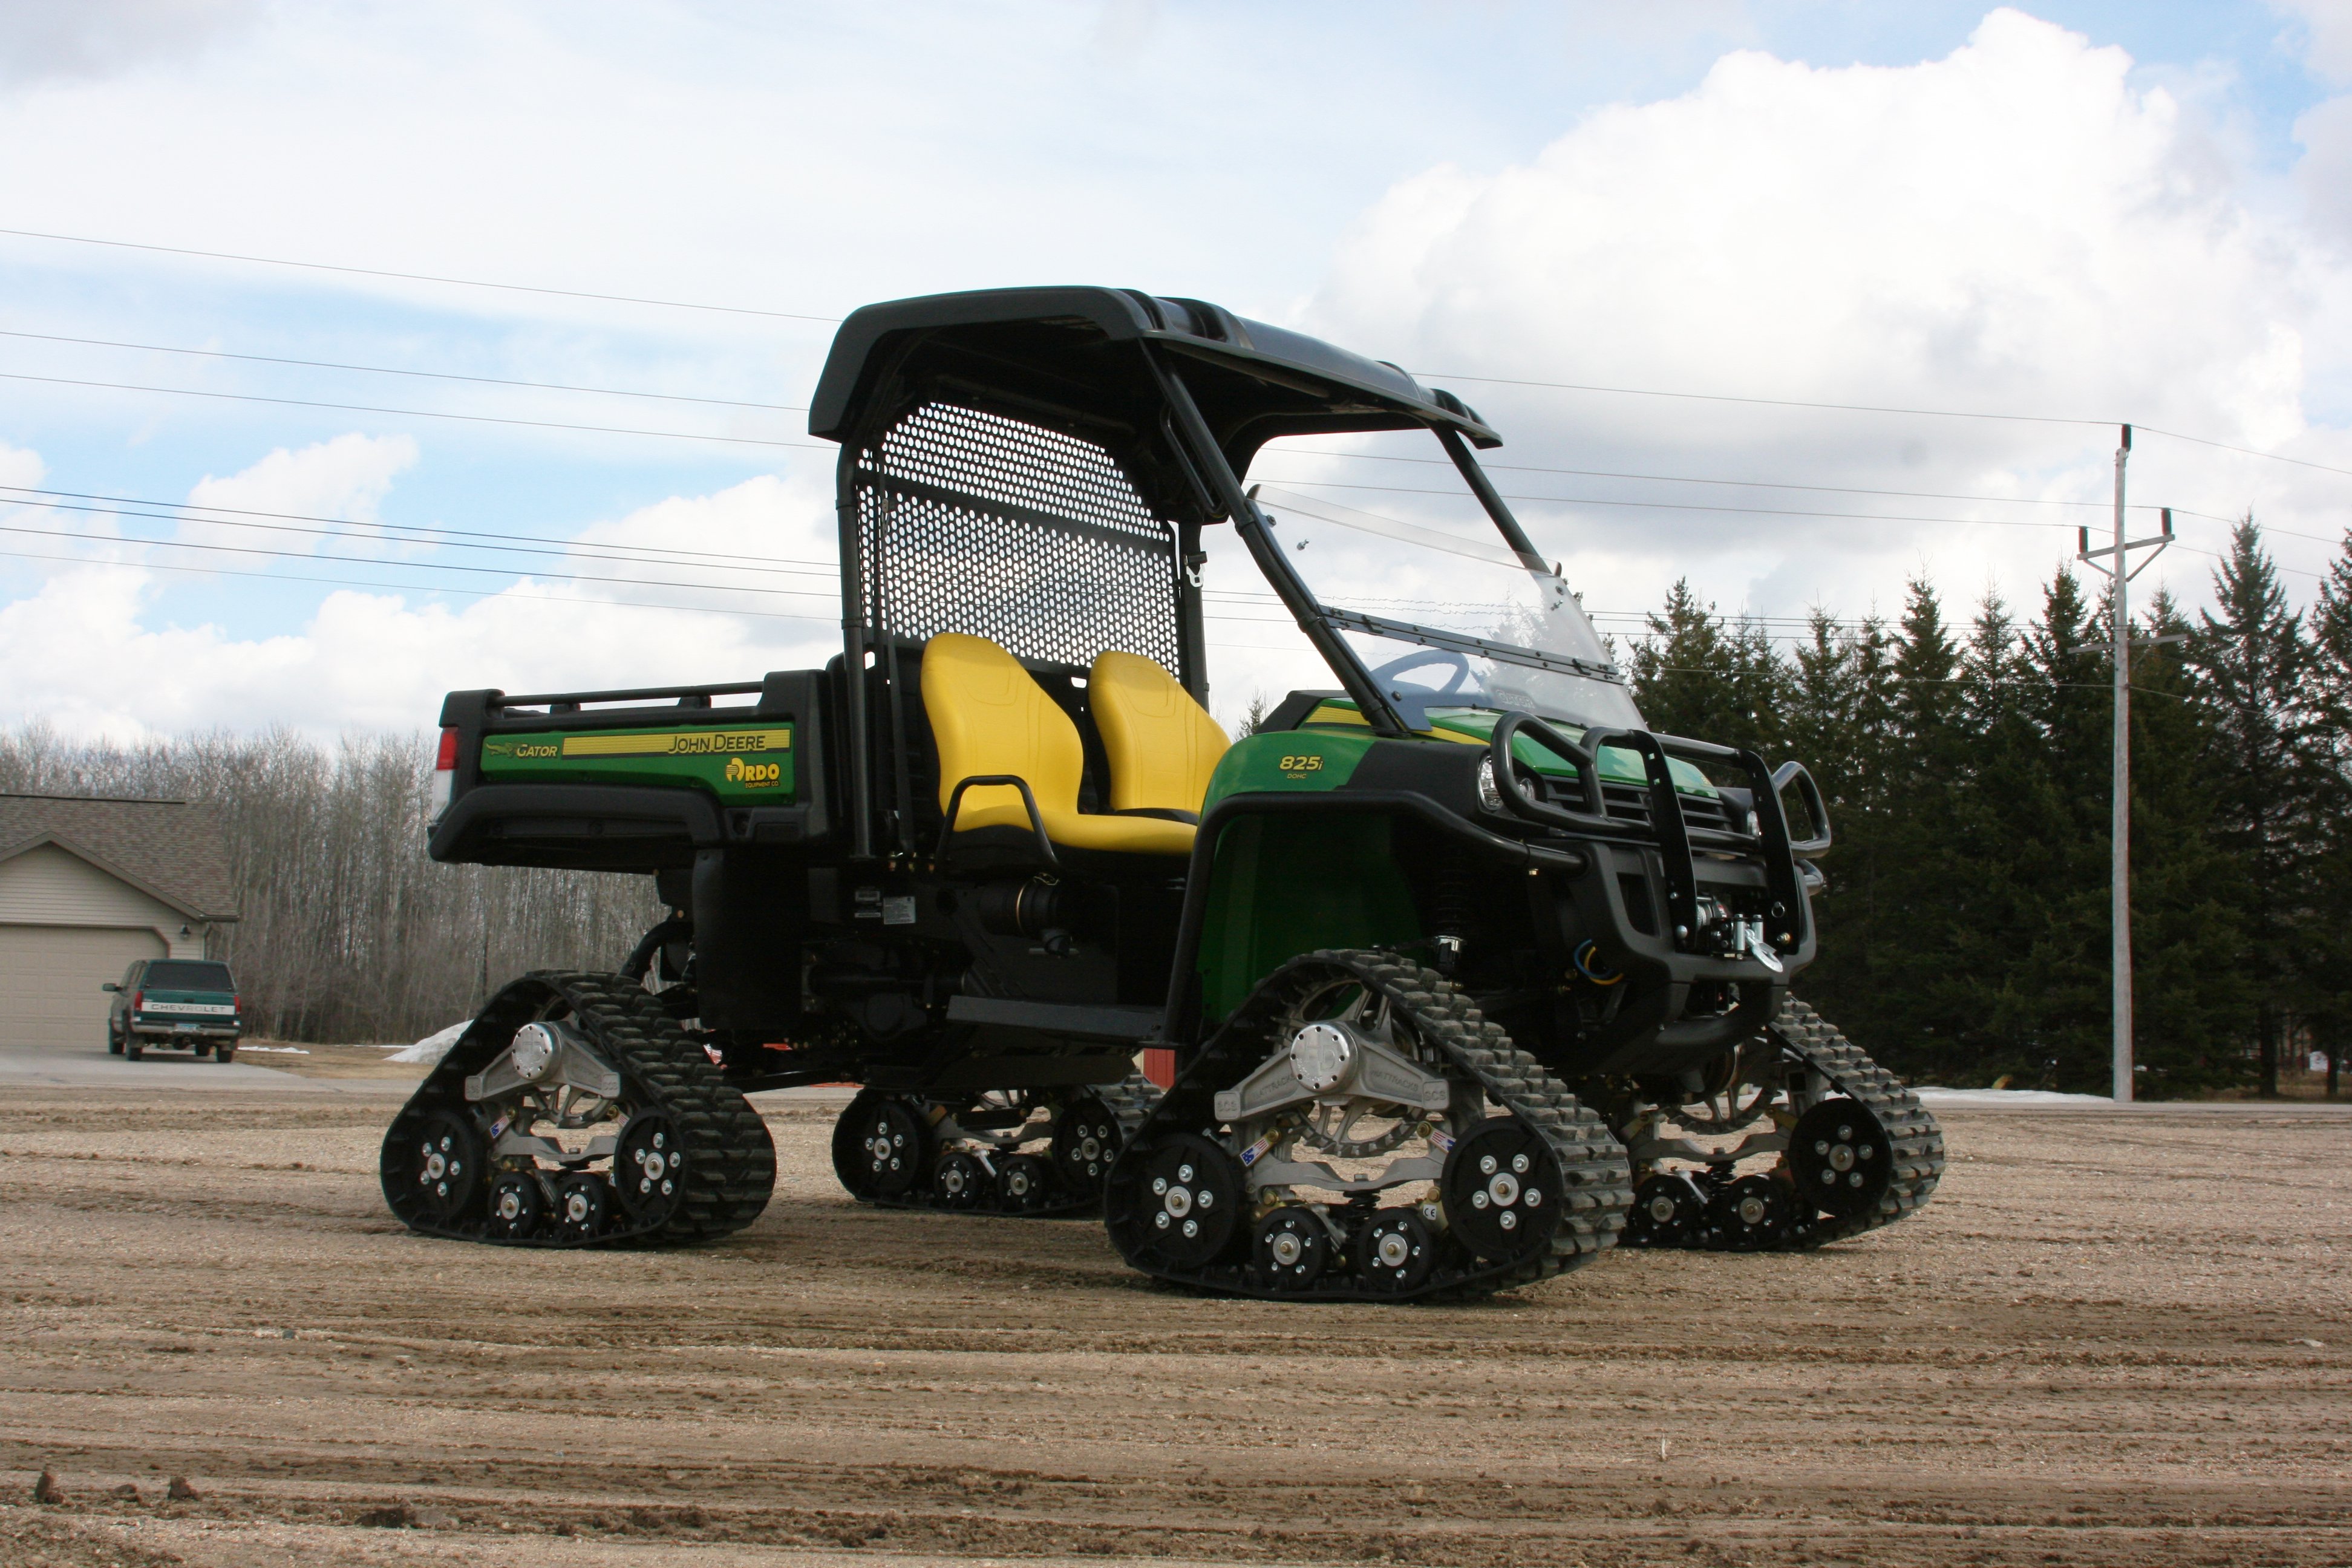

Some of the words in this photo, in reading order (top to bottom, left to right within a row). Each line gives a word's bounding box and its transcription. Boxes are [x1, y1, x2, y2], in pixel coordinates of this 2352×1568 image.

[668, 736, 710, 752] JOHN
[714, 731, 765, 750] DEERE
[517, 743, 557, 757] GATOR
[1279, 756, 1324, 771] 825i
[151, 1004, 226, 1013] CHEVROLET
[1424, 1208, 1436, 1217] CE
